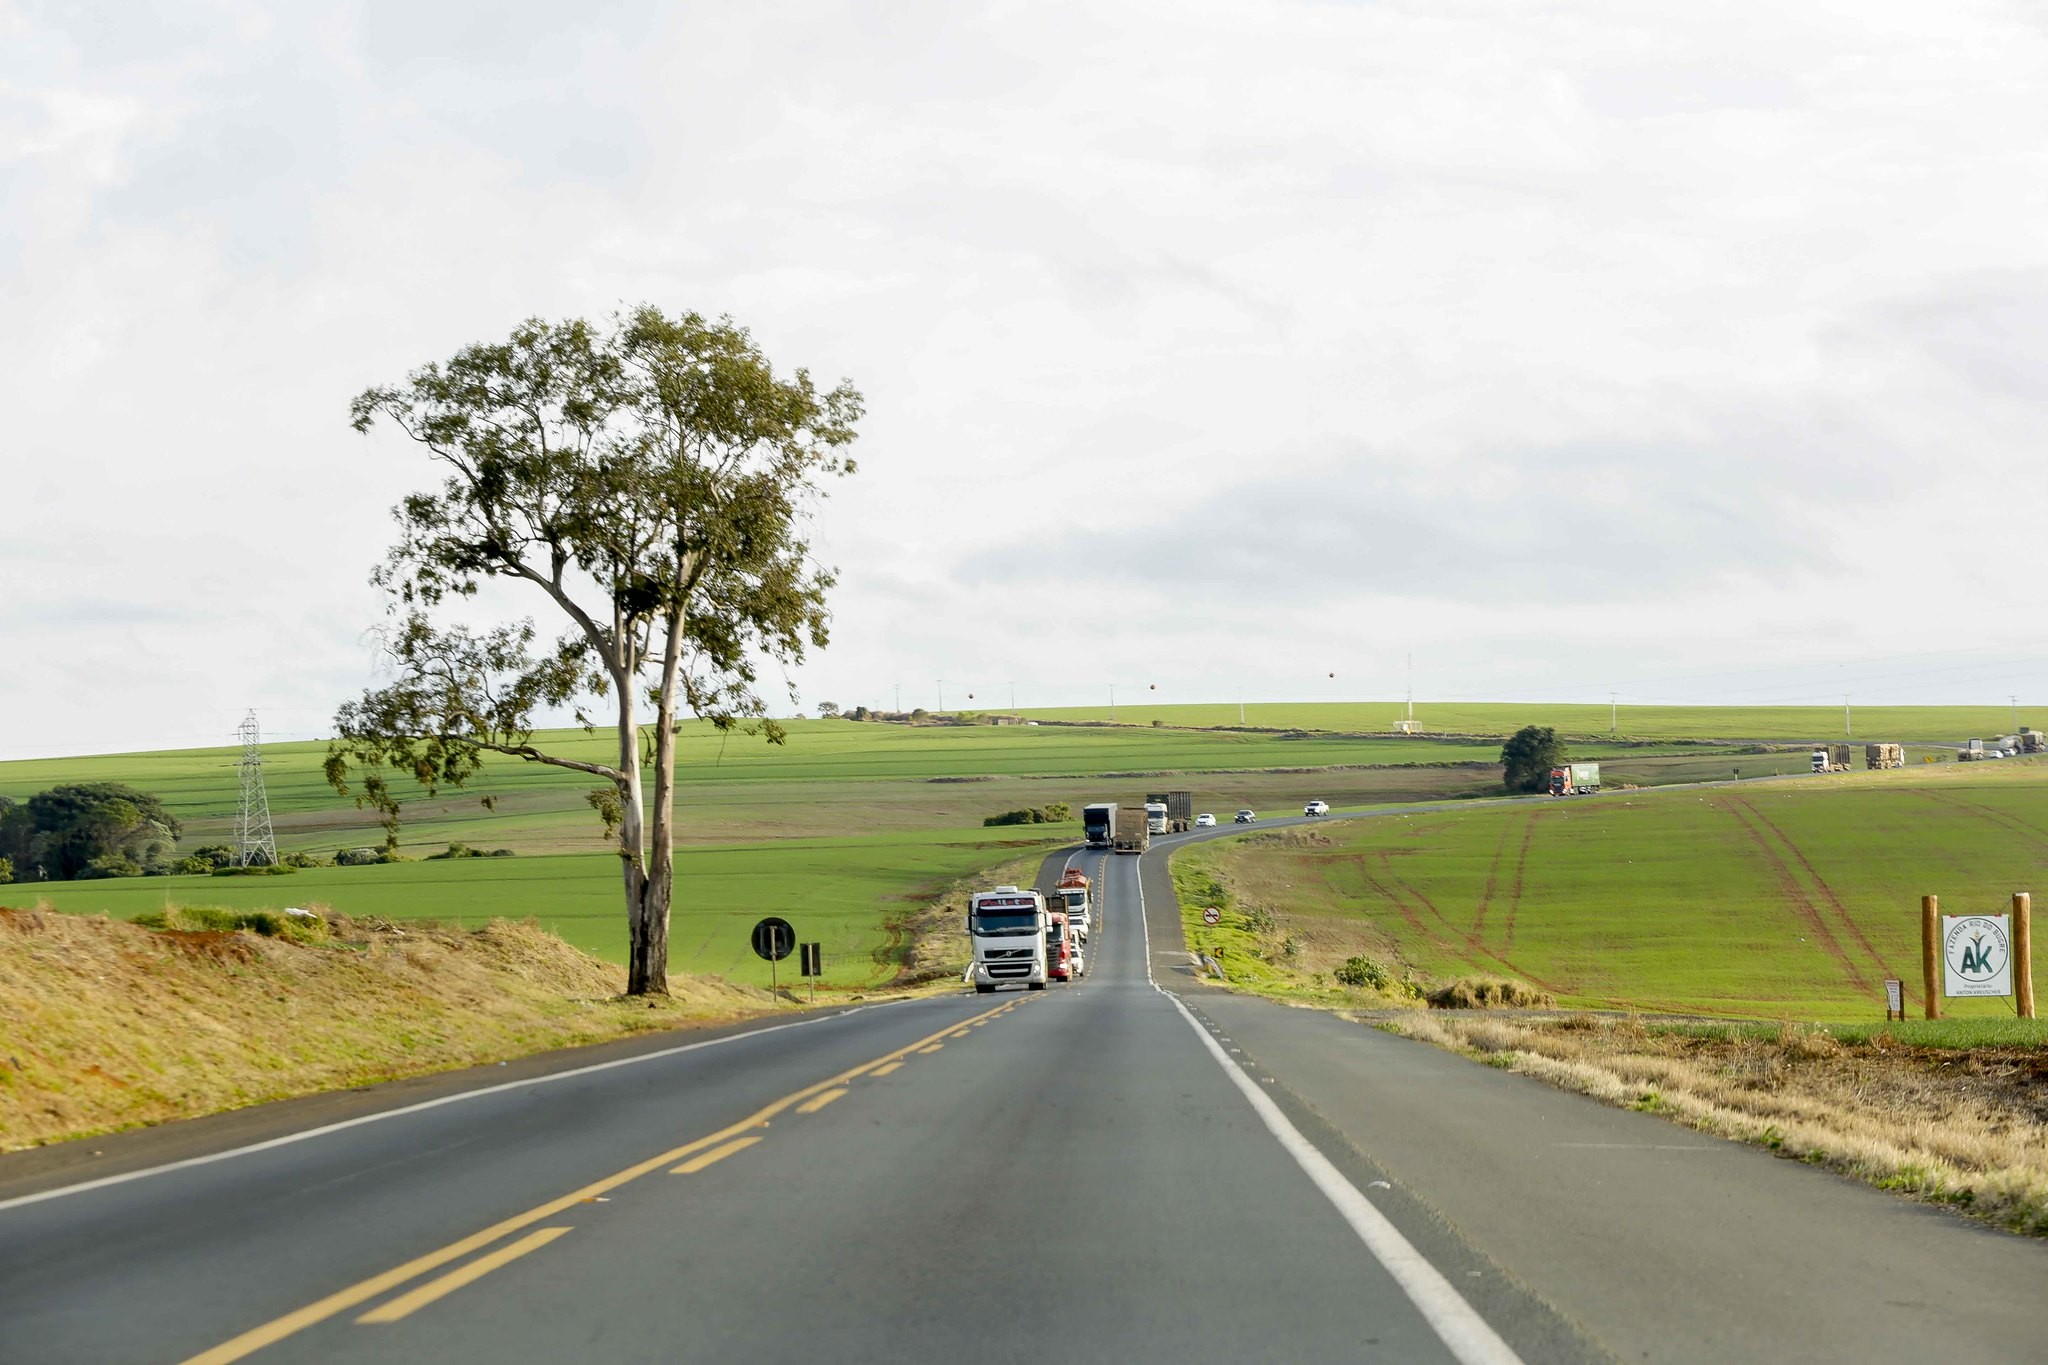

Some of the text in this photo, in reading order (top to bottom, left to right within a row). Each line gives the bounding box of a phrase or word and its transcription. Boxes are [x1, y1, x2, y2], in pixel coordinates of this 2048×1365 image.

[1949, 924, 1967, 954] FAZENDA
[1983, 922, 1993, 930] DO
[1993, 930, 2005, 953] BUGRE
[1960, 945, 1993, 973] AK
